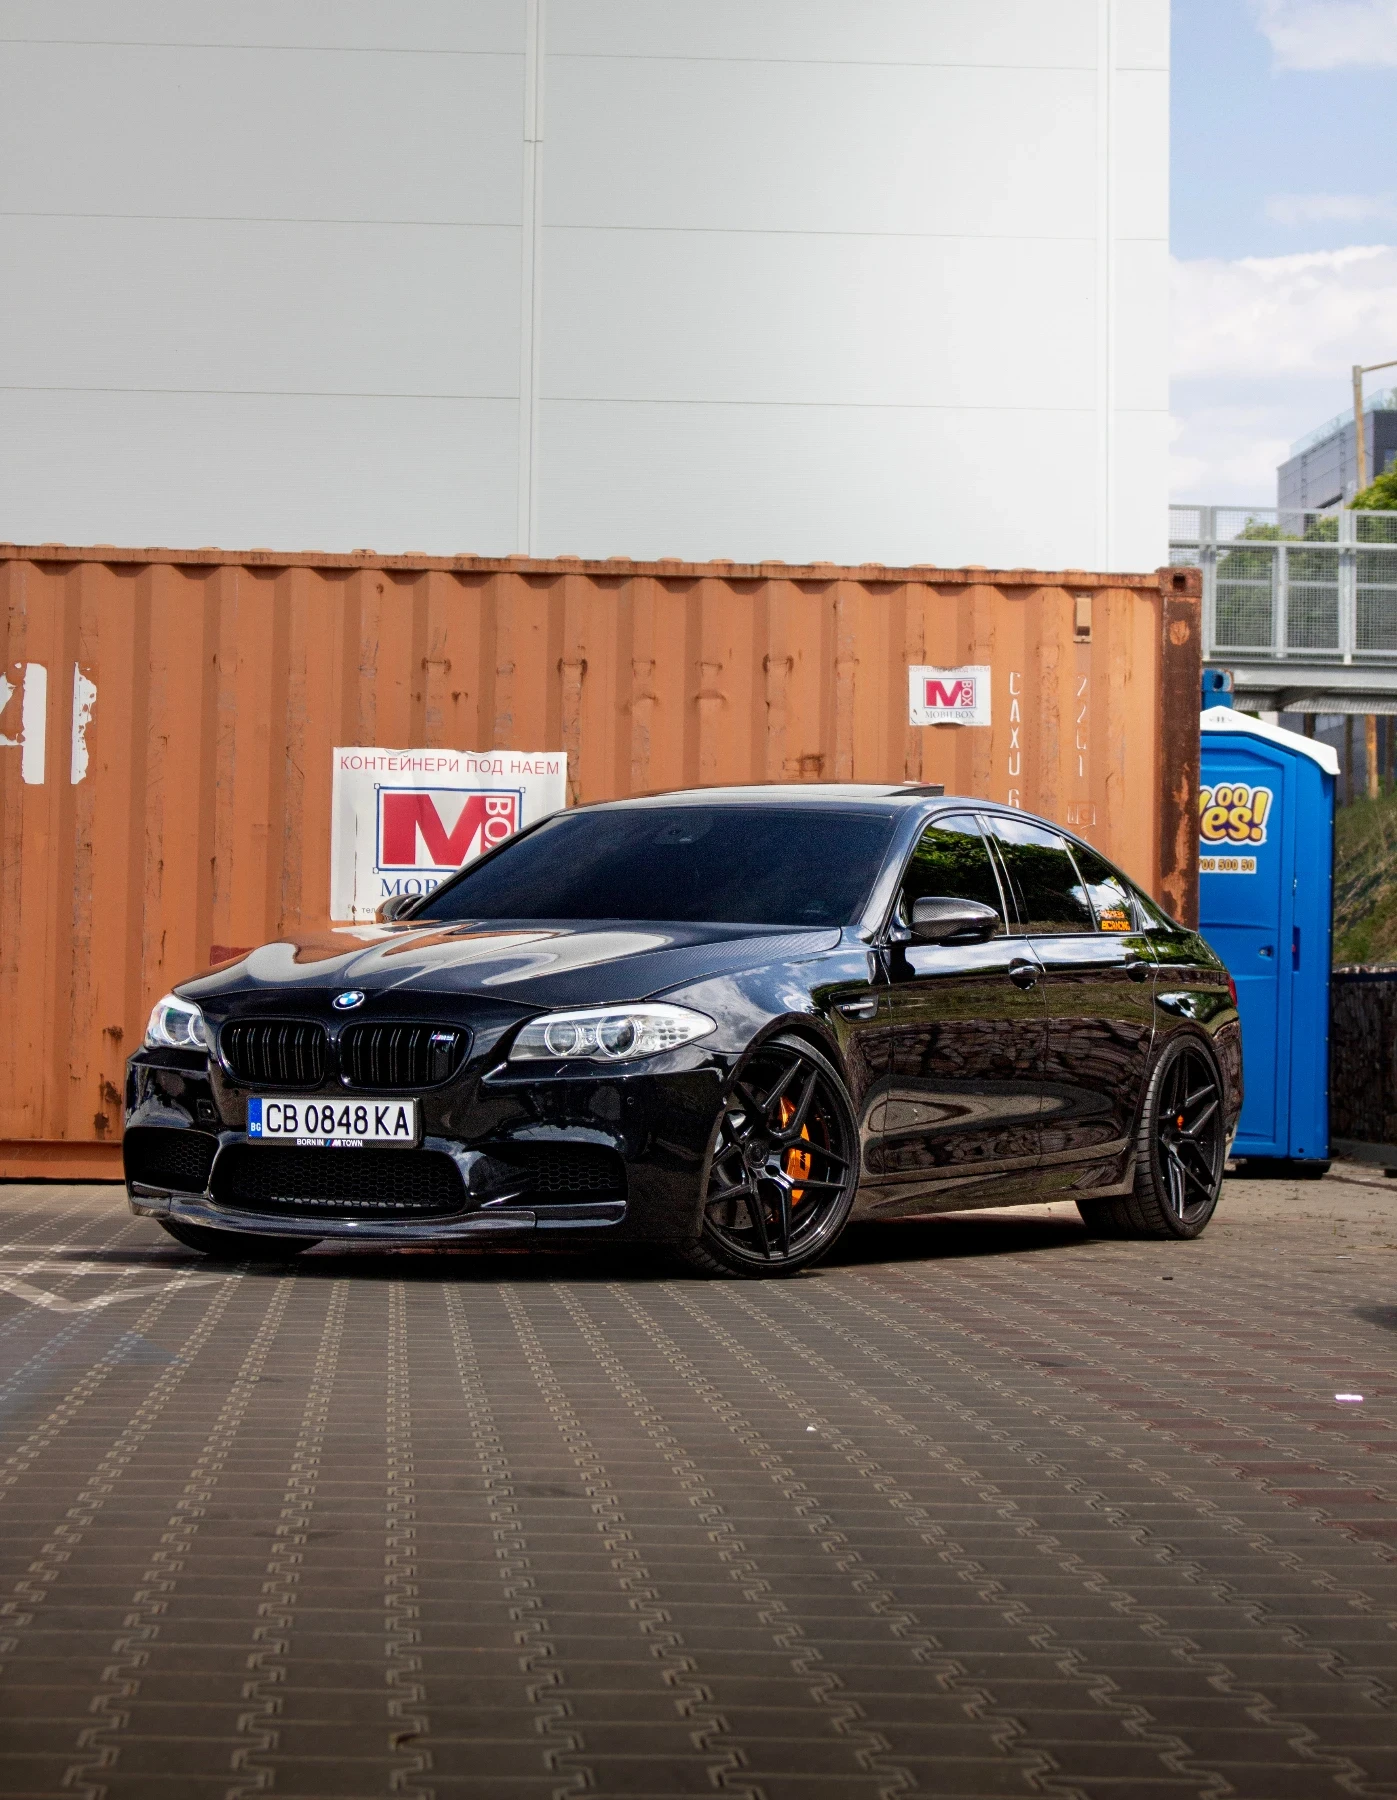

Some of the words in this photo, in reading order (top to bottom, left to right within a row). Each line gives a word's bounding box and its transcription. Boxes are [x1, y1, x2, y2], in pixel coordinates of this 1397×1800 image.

[961, 680, 973, 706] BOX
[1008, 671, 1021, 776] CAXU
[340, 755, 459, 773] КОНТЕЙНЕРИ
[466, 759, 503, 775] ПОД
[510, 761, 559, 775] НАЕМ
[484, 797, 512, 850] BO
[1218, 859, 1238, 871] 500
[1241, 859, 1255, 871] 50
[250, 1122, 262, 1132] BG
[266, 1103, 299, 1133] CB
[304, 1104, 369, 1135] 0848
[375, 1105, 410, 1136] KA
[342, 1139, 363, 1147] TOWN
